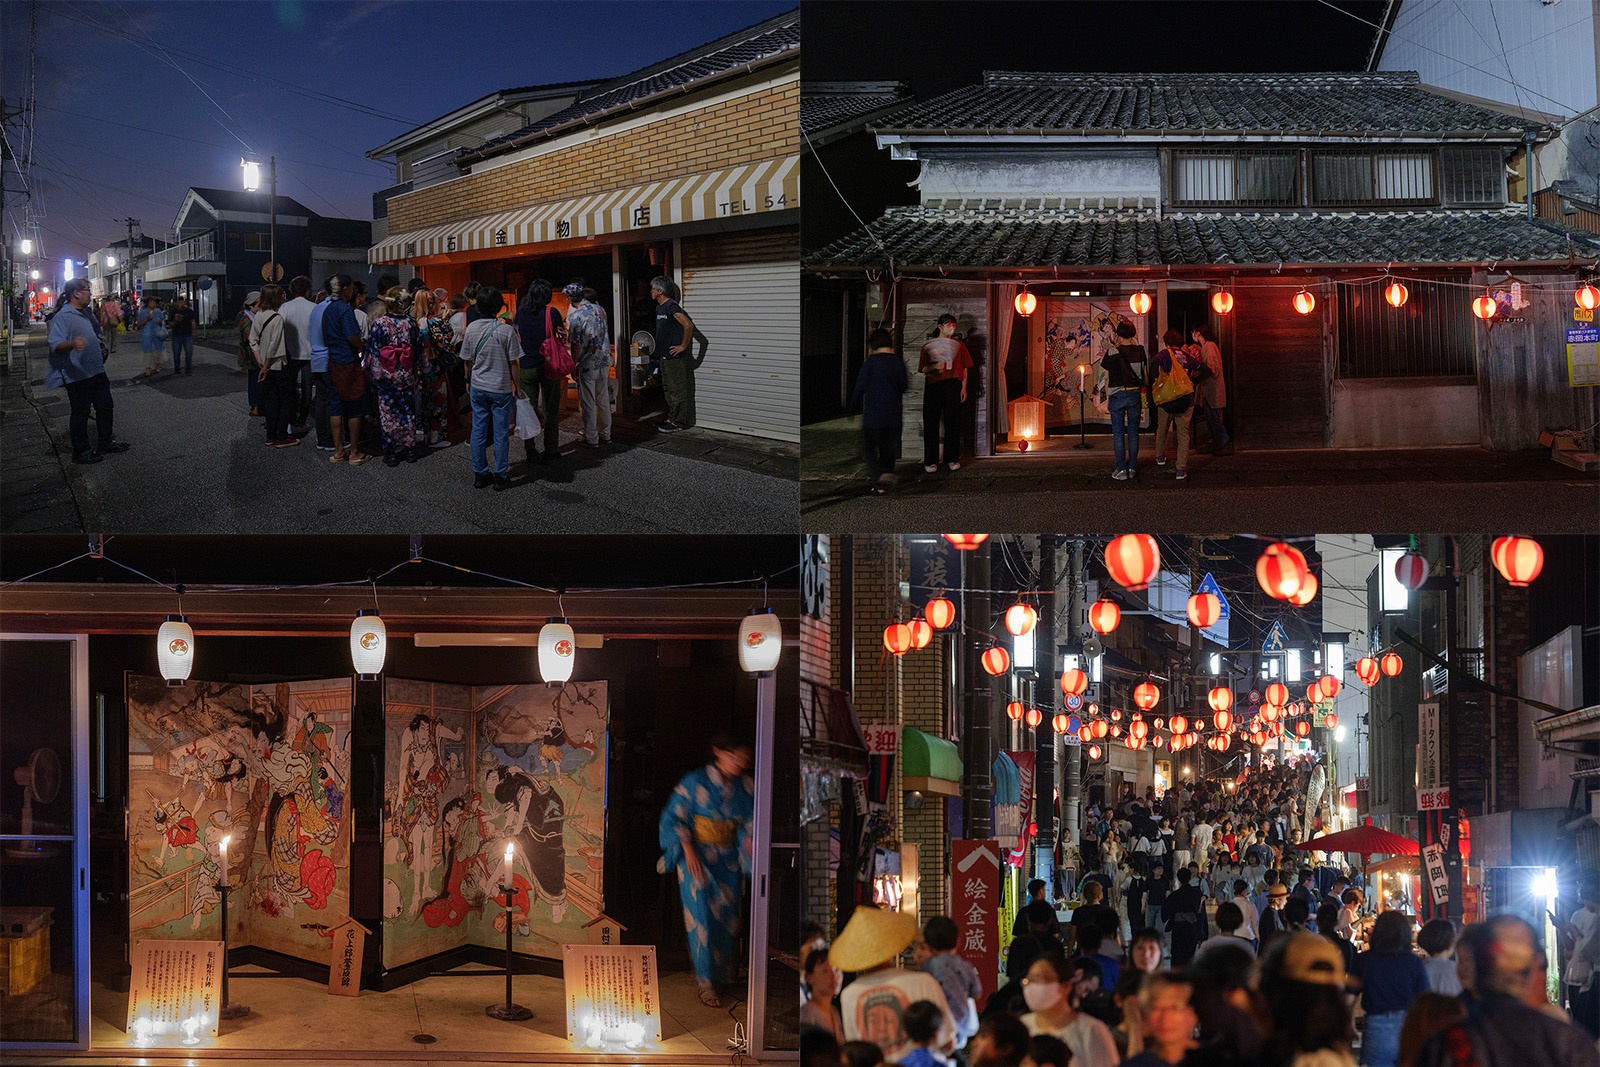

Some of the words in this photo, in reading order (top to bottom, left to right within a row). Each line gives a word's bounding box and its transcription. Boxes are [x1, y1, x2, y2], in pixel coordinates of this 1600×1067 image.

[719, 199, 751, 215] TEL
[1069, 696, 1079, 706] 30
[963, 877, 989, 953] 絵金蔵
[601, 926, 610, 945] 田村
